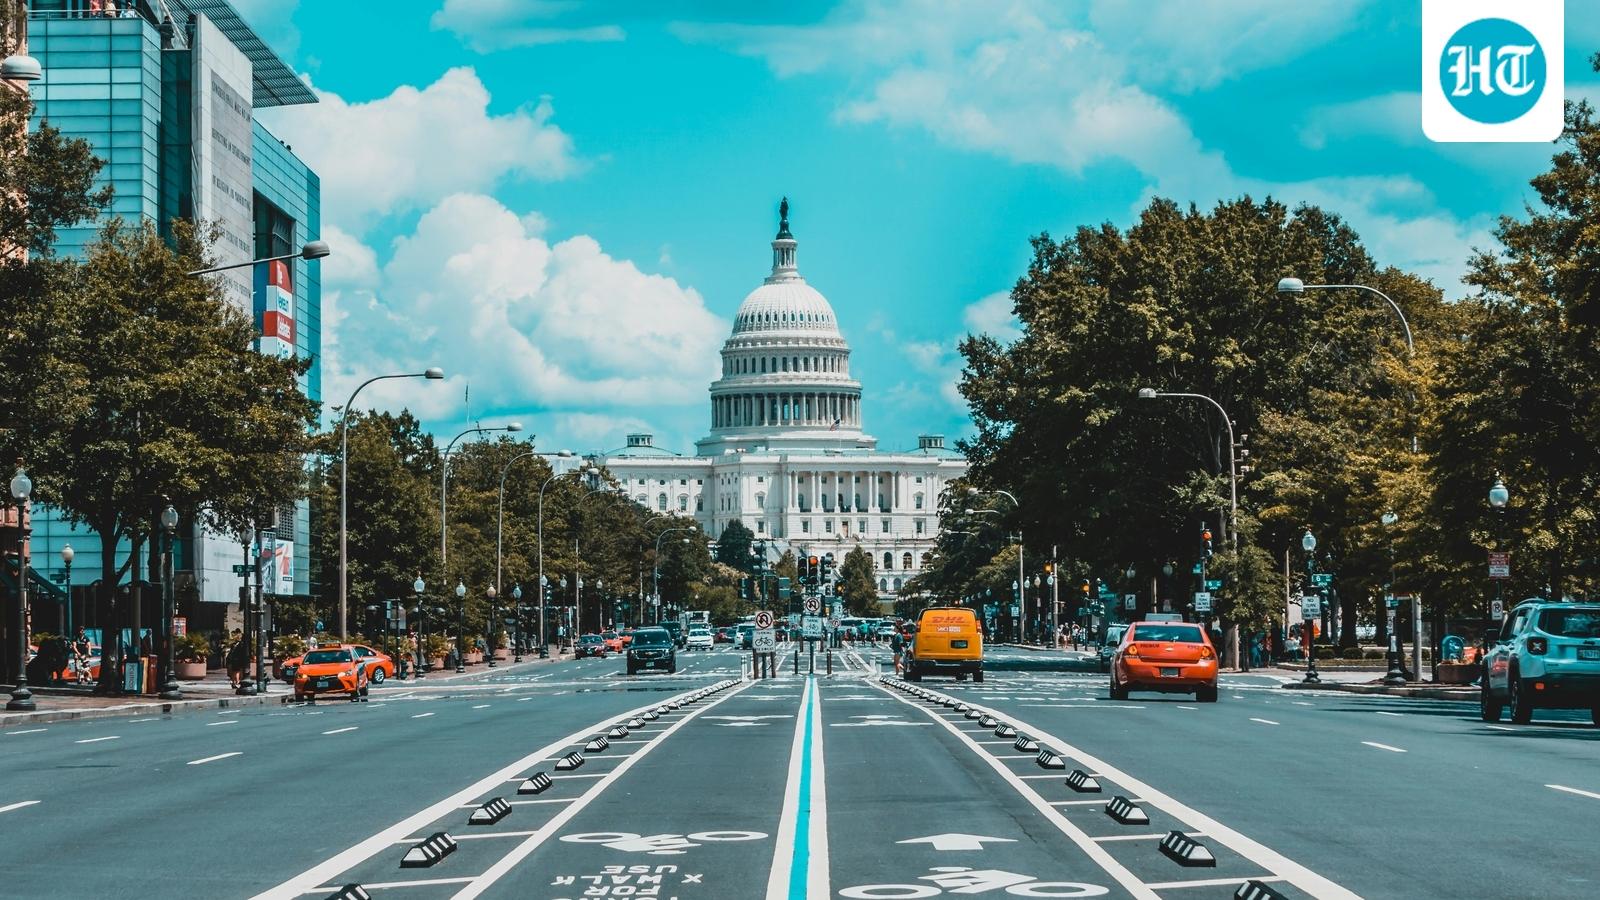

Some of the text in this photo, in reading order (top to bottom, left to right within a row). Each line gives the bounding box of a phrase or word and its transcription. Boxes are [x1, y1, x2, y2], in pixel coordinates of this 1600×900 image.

[932, 616, 966, 624] DHL
[600, 864, 678, 874] USE
[551, 873, 704, 886] X WALK
[584, 885, 661, 896] FOR
